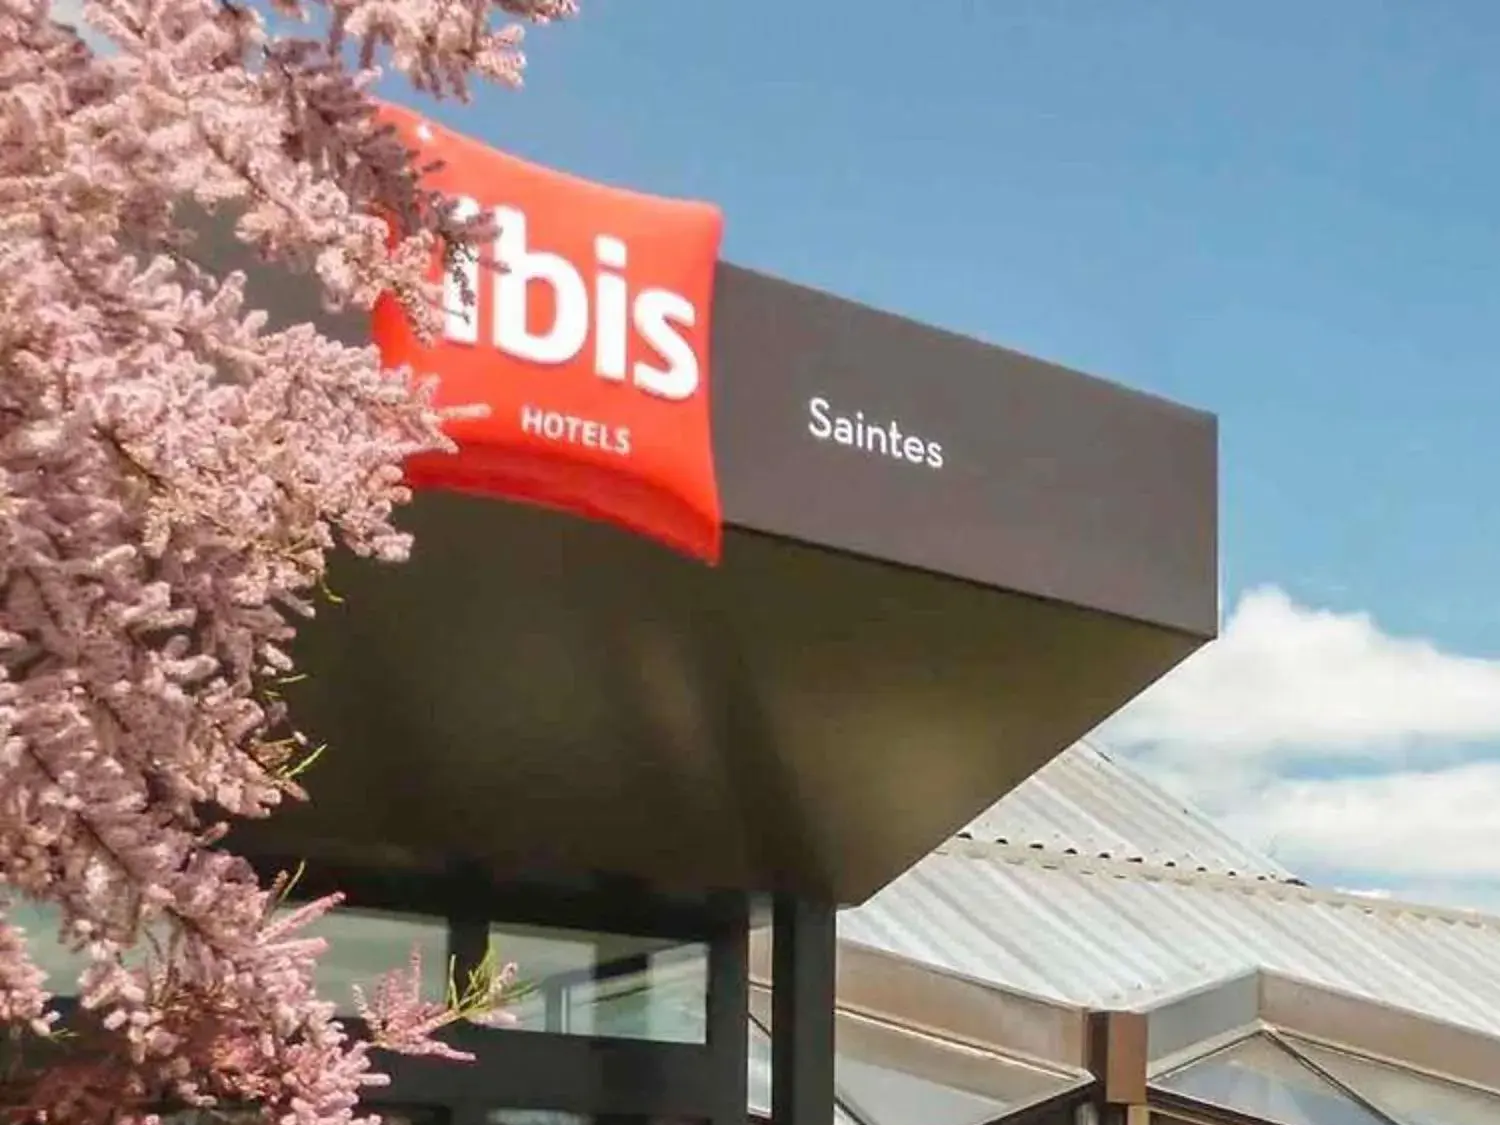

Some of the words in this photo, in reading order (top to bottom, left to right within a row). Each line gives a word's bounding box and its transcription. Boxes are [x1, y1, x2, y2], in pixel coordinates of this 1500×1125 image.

[443, 196, 700, 400] ibis
[521, 405, 632, 455] HOTELS
[807, 396, 944, 469] Saintes
